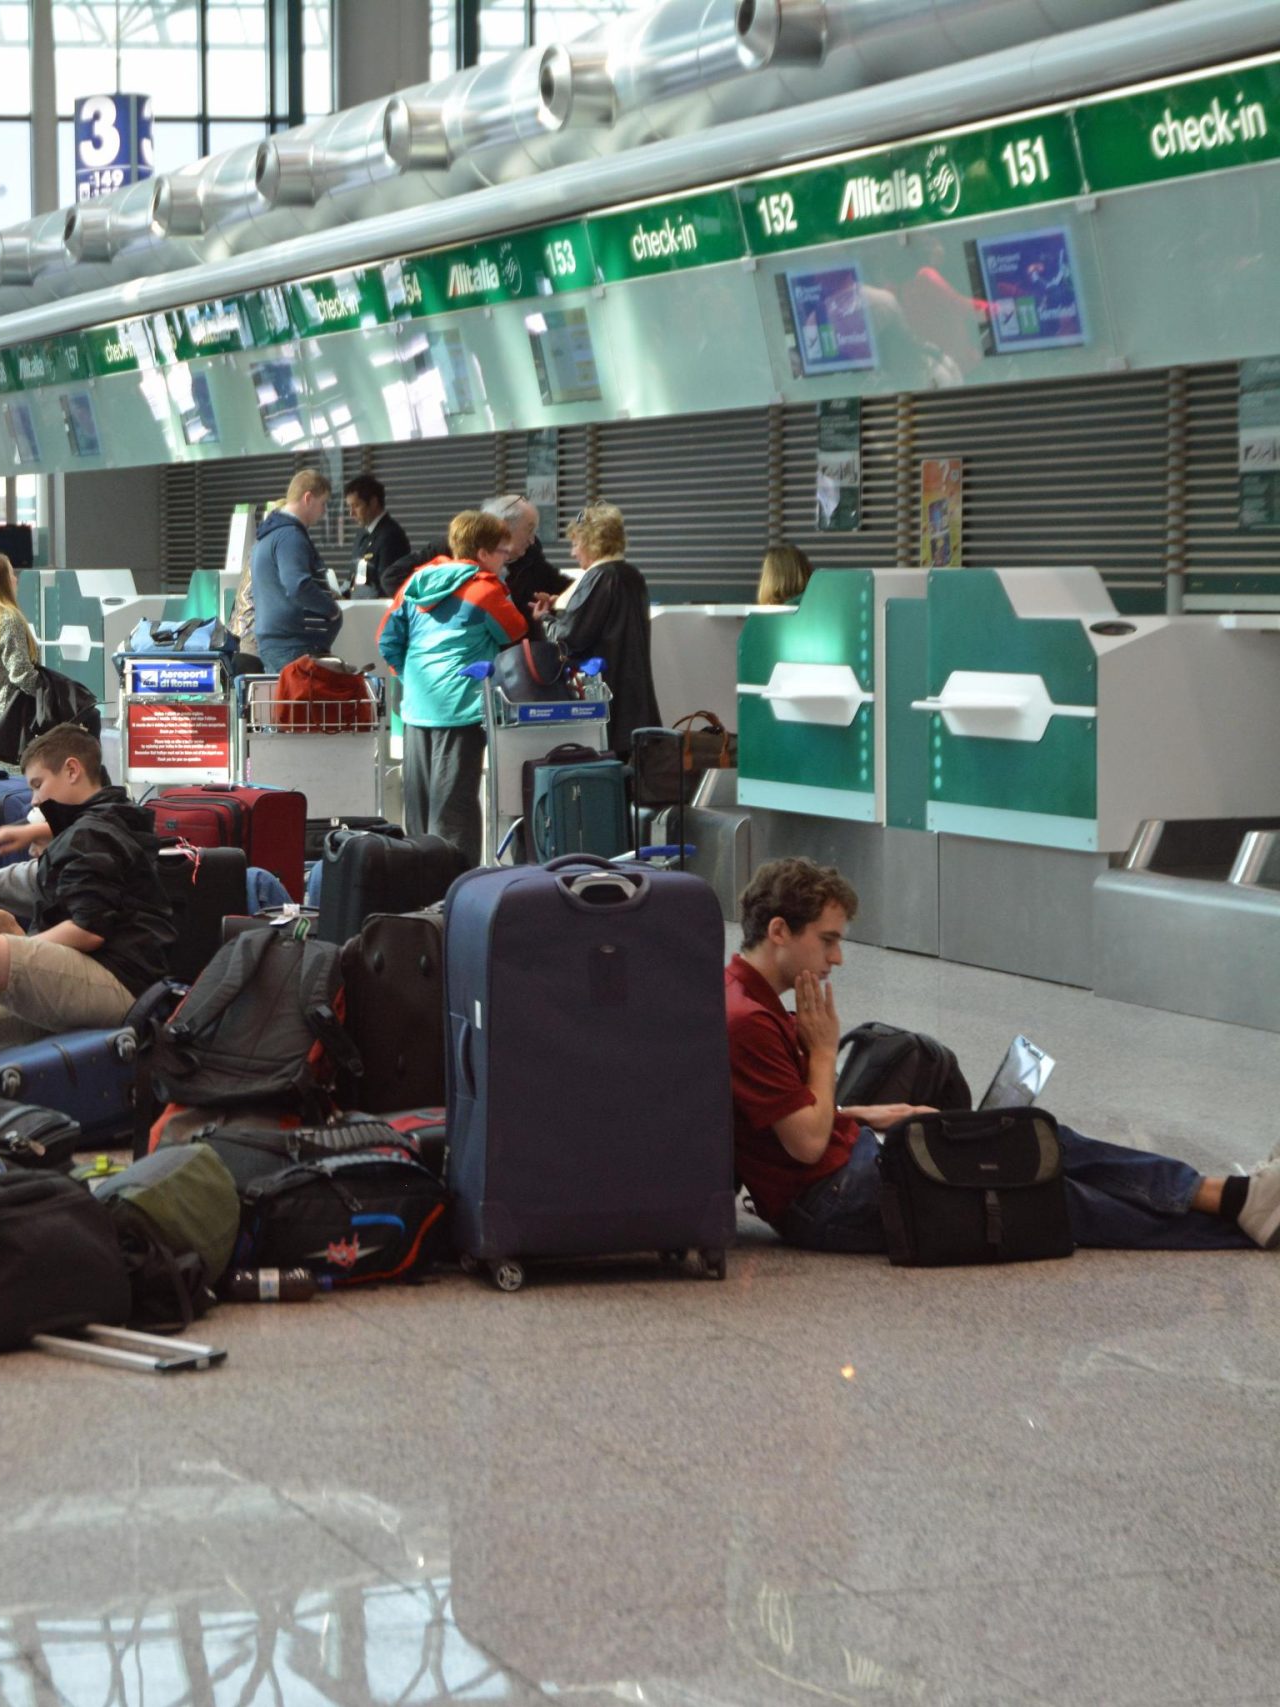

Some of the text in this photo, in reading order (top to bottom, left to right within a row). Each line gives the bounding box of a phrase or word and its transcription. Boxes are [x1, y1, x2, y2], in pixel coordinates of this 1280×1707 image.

[79, 95, 120, 168] 3
[1151, 91, 1267, 160] check-in
[757, 192, 798, 237] 152
[838, 168, 924, 224] Alitalia
[1001, 135, 1050, 188] 151
[631, 214, 698, 261] check-in
[448, 258, 501, 298] Alitalia
[544, 238, 577, 276] 153
[316, 288, 360, 321] check-in
[160, 670, 208, 680] Aeroporti
[160, 679, 199, 688] di Roma
